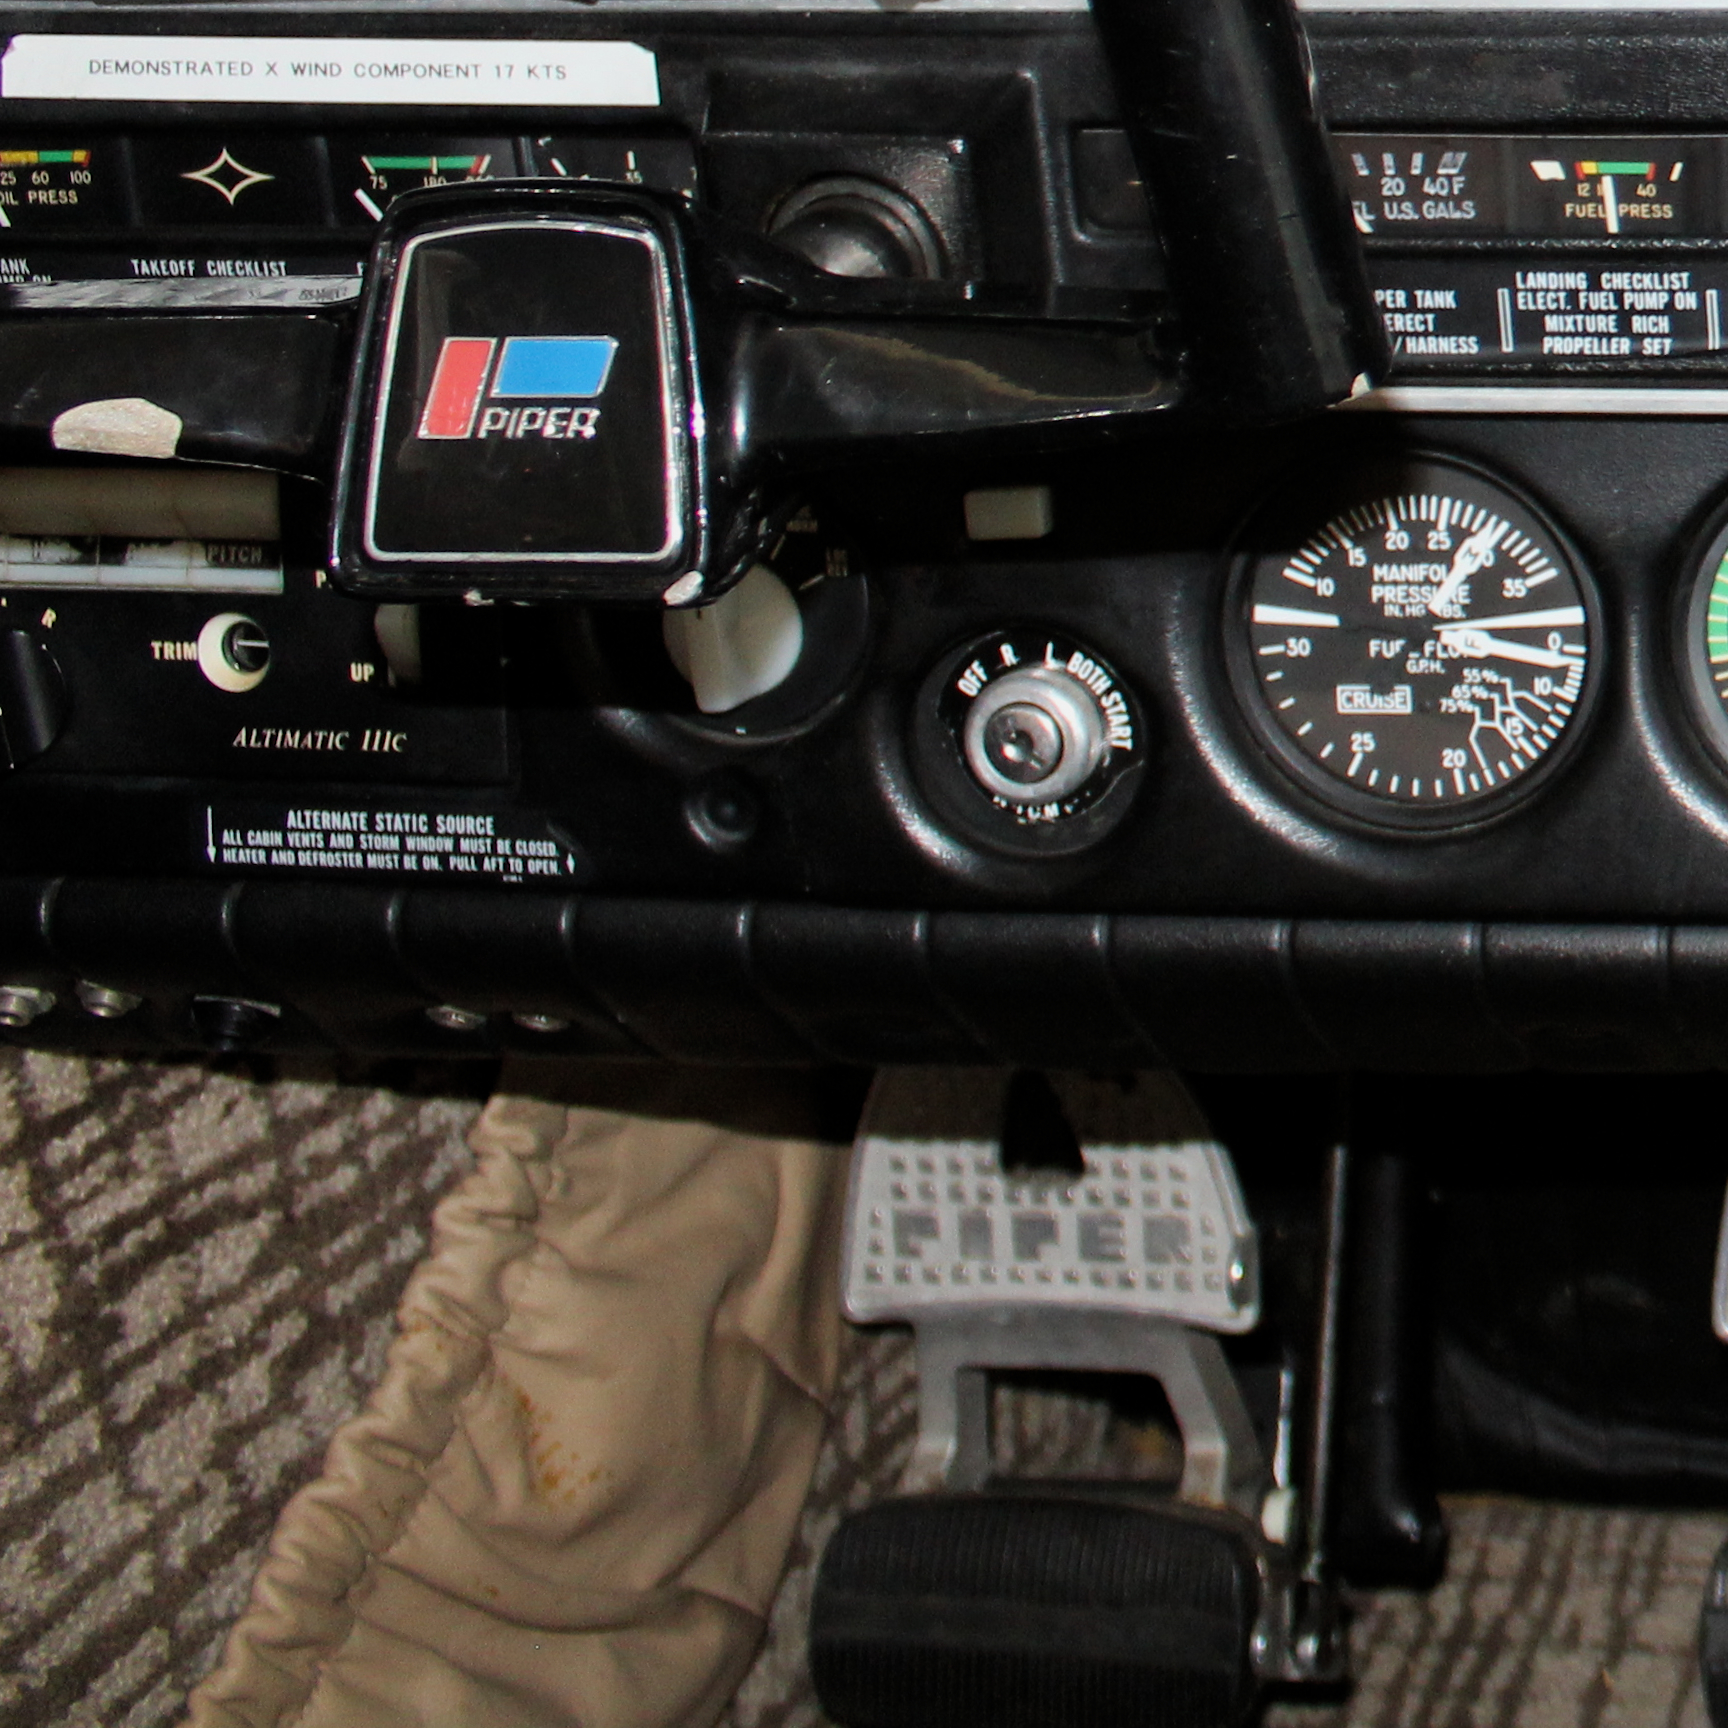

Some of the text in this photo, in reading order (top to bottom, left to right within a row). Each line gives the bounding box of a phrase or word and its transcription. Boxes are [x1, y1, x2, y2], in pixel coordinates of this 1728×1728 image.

[89, 59, 567, 80] DEMONSTRATED X WIND COMPONENT 17 KTS
[1618, 203, 1673, 218] PRESS
[130, 258, 287, 277] TAKEOFF CHECKLIST
[1515, 272, 1690, 290] LANDING CHECKLIST
[1544, 314, 1669, 334] MIXTURE RICH
[477, 407, 601, 440] PIPER
[150, 640, 197, 661] TRIM
[1340, 690, 1408, 710] CRUISE
[1102, 690, 1132, 751] START
[233, 726, 349, 752] ALTIMATIC
[286, 809, 494, 836] ALTERNATE STATIC SOURCE
